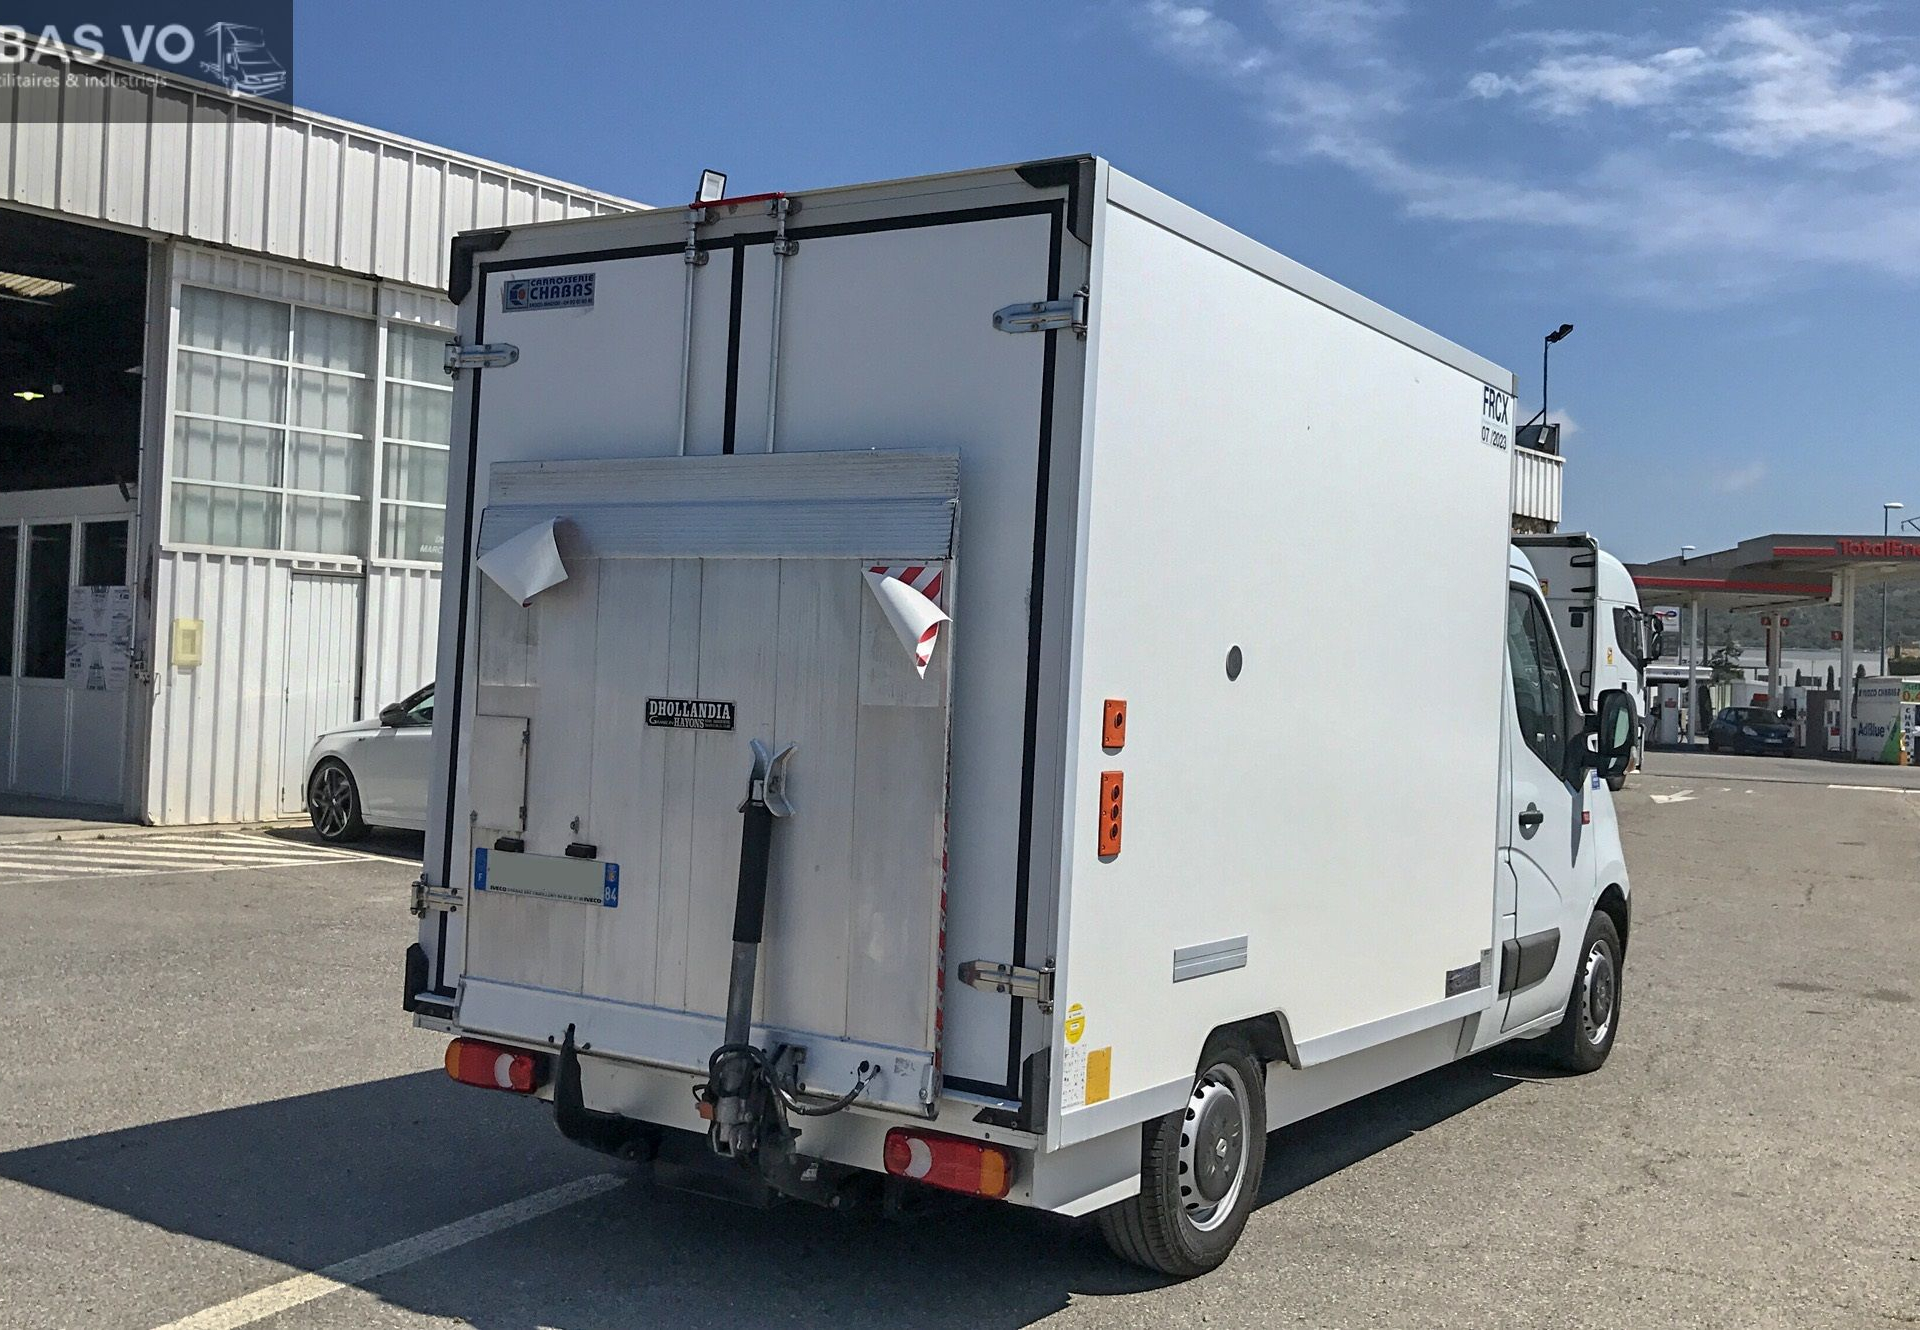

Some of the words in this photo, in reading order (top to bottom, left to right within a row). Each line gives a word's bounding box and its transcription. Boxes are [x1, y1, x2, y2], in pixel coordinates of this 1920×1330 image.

[530, 274, 594, 287] CARROSSERIE
[530, 283, 593, 300] CHABAS
[1483, 385, 1509, 425] FRCX
[649, 700, 731, 720] DHOLLANDIA
[673, 717, 704, 729] HAYONS
[1858, 722, 1885, 738] AdBlue
[478, 872, 483, 881] F
[490, 884, 507, 892] IVECO
[604, 886, 617, 902] 84
[584, 896, 602, 904] IVECO
